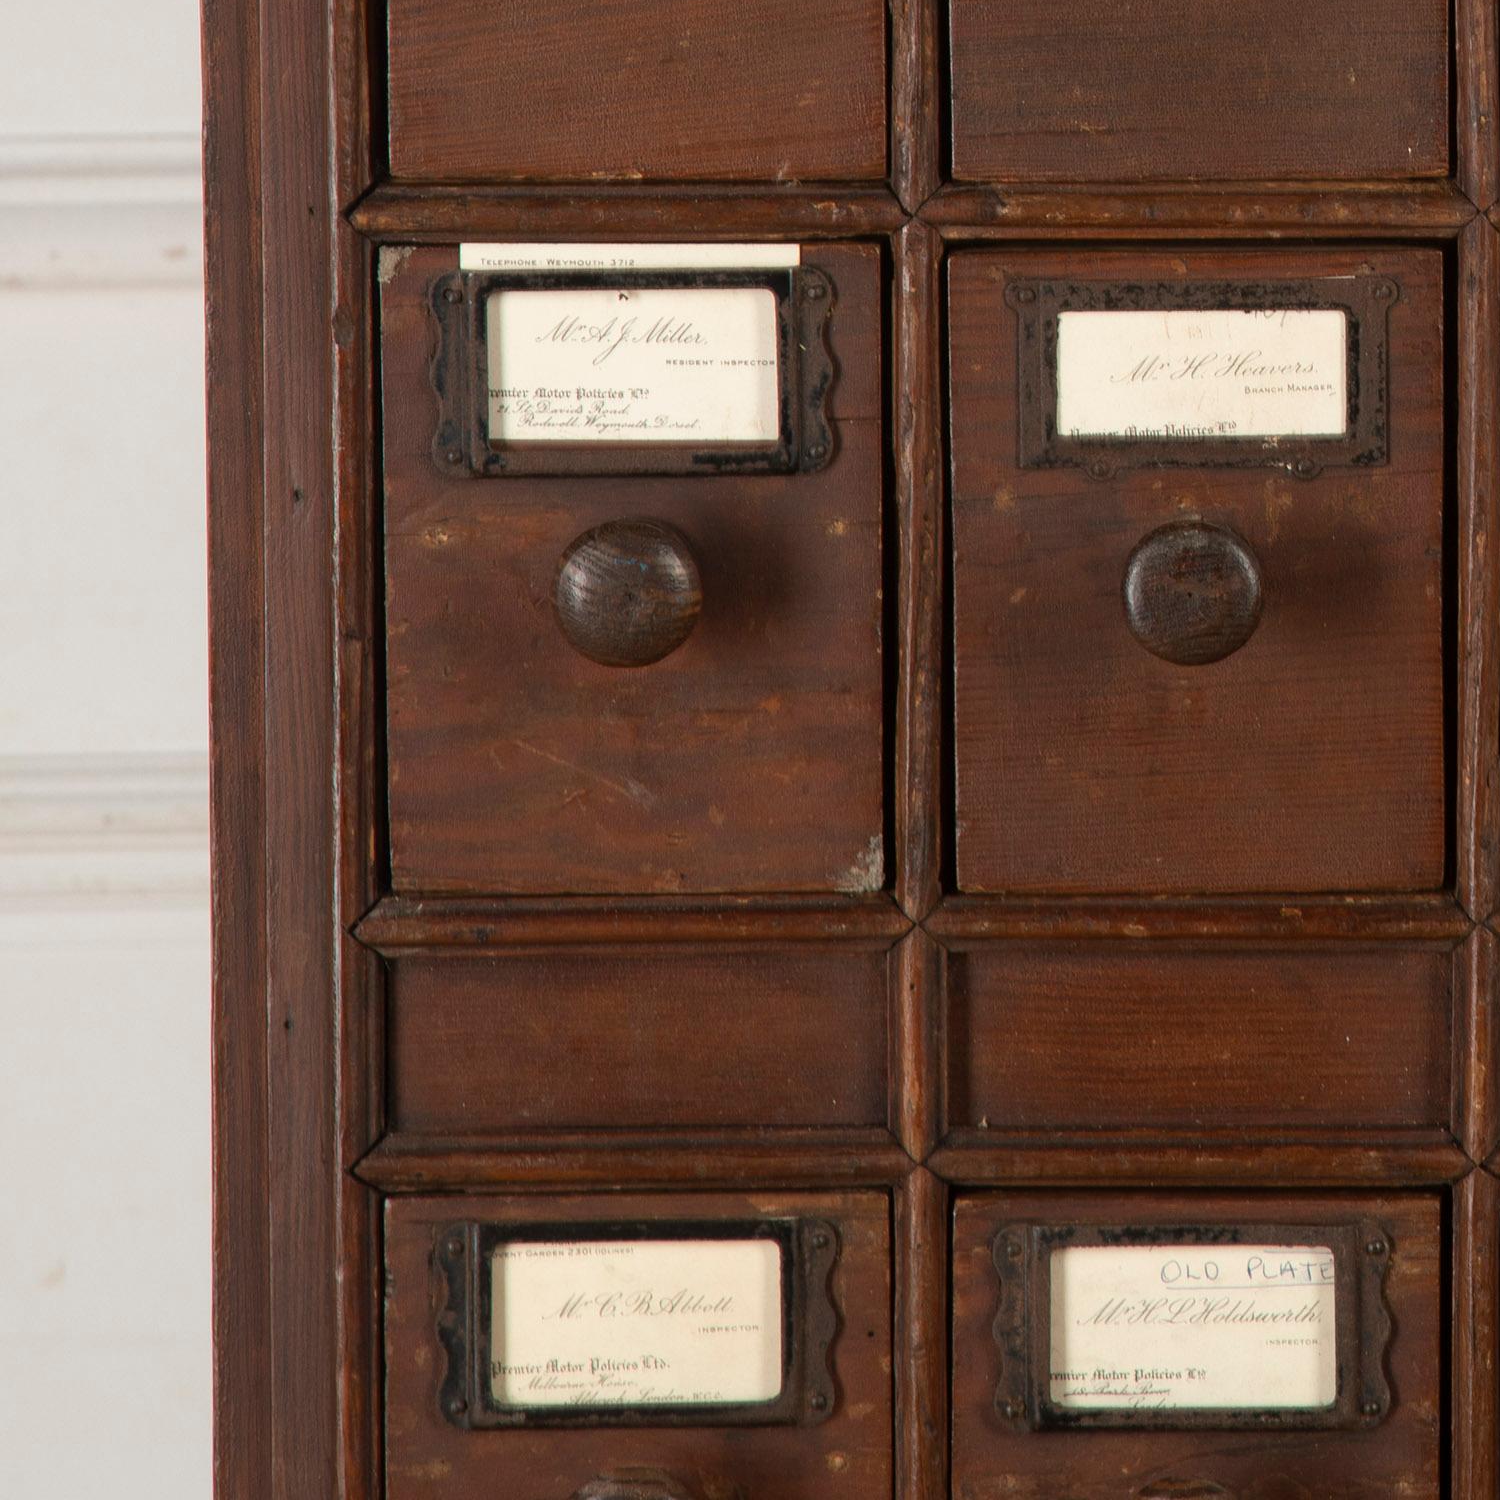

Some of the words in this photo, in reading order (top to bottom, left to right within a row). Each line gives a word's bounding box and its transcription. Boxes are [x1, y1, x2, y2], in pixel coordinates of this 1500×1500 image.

[547, 258, 605, 266] WEYMOUTH
[534, 388, 571, 399] Motor
[576, 386, 624, 402] Policies
[1244, 386, 1283, 395] BRANCH
[1160, 1259, 1219, 1282] OLD
[1247, 1256, 1334, 1282] PLATE
[546, 1359, 583, 1374] Motor
[591, 1357, 638, 1374] Policies
[1092, 1368, 1130, 1381] Motor
[1134, 1368, 1182, 1382] Policies
